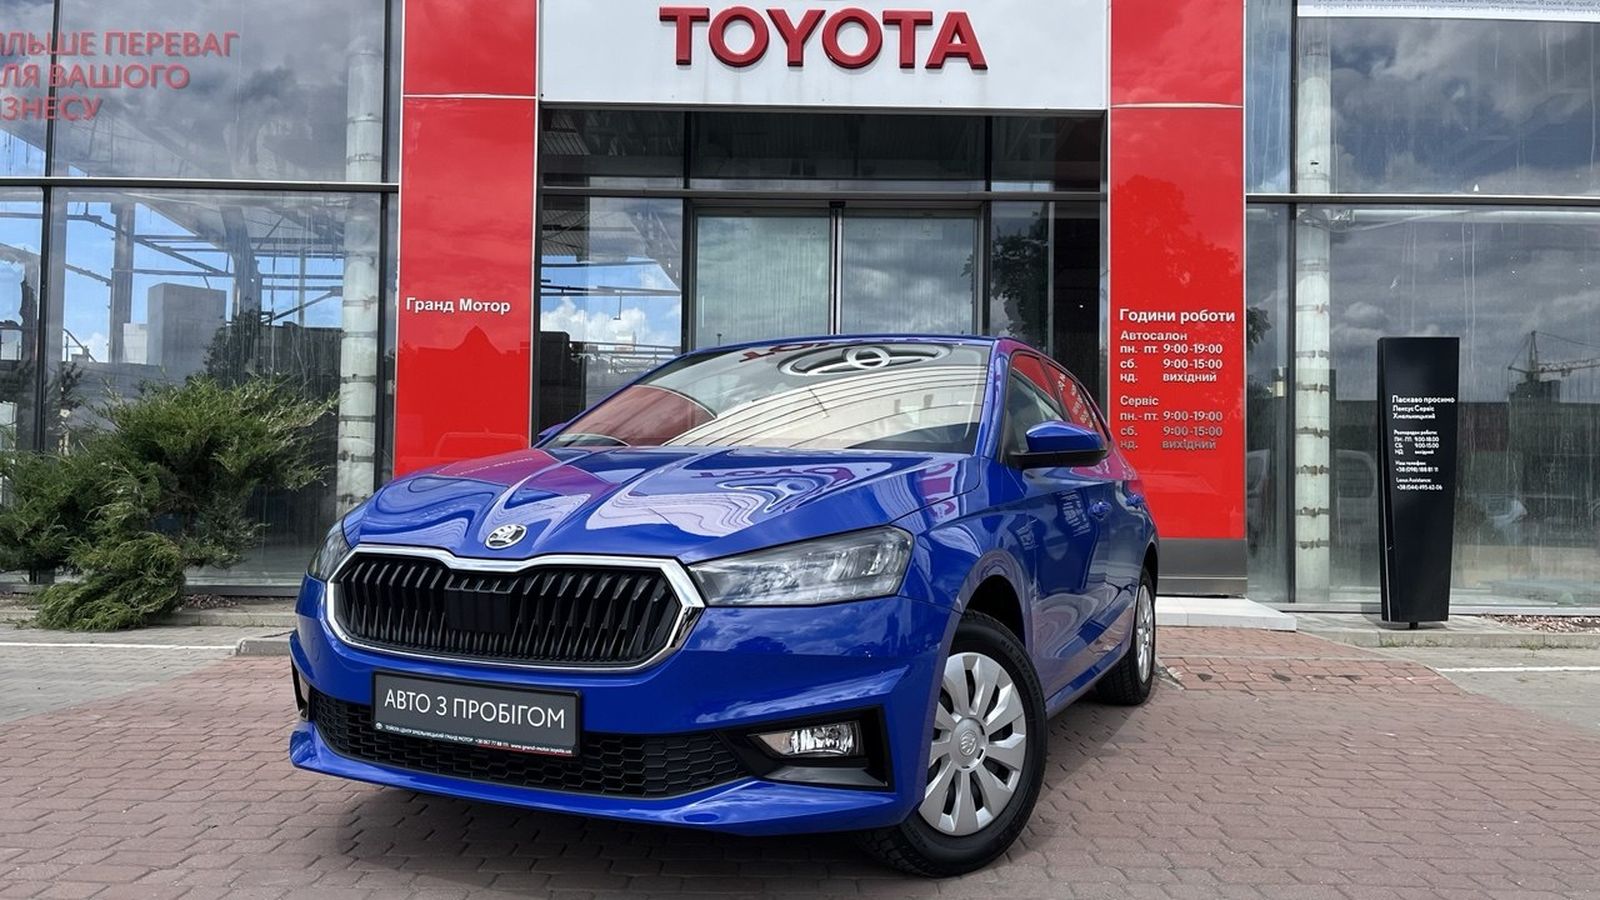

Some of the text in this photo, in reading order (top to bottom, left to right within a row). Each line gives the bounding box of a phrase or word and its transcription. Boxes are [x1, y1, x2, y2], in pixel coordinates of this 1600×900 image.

[104, 31, 240, 57] ПЕРЕВАГ
[659, 6, 988, 70] TOYOTA
[49, 63, 191, 89] ВАШОГО
[406, 297, 511, 315] Гранд Мотор
[1119, 309, 1236, 324] Години роботи
[1120, 330, 1188, 341] Автосалон
[1120, 358, 1138, 369] сб.
[1120, 371, 1217, 384] нд. вихідний
[1120, 395, 1159, 407] Сервіс
[1120, 425, 1138, 436] сб.
[1120, 438, 1217, 450] нд. вихідний
[384, 688, 565, 729] АВТО З ПРОБІГОМ
